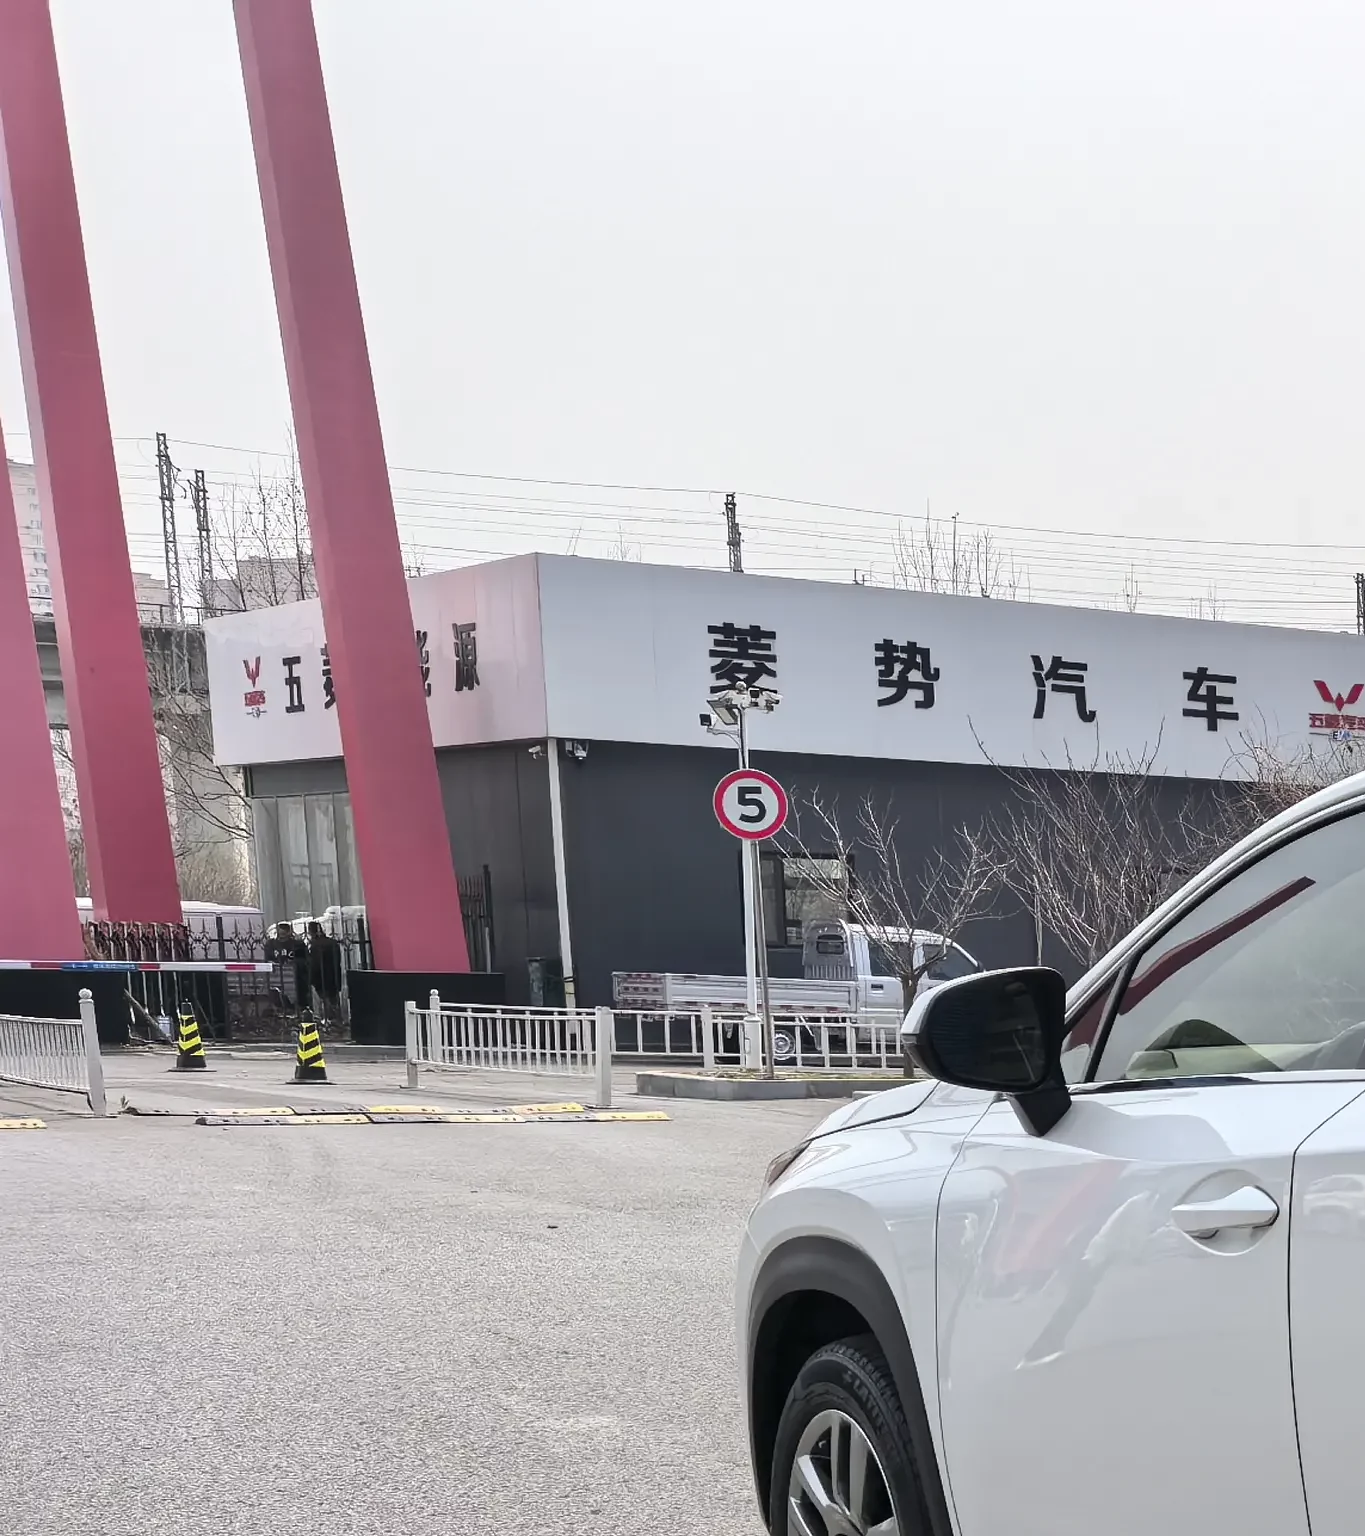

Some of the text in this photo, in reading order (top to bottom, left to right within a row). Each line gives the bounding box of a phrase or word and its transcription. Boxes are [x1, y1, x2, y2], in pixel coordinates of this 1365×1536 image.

[707, 622, 1239, 731] 菱势汽车
[737, 786, 767, 823] 5
